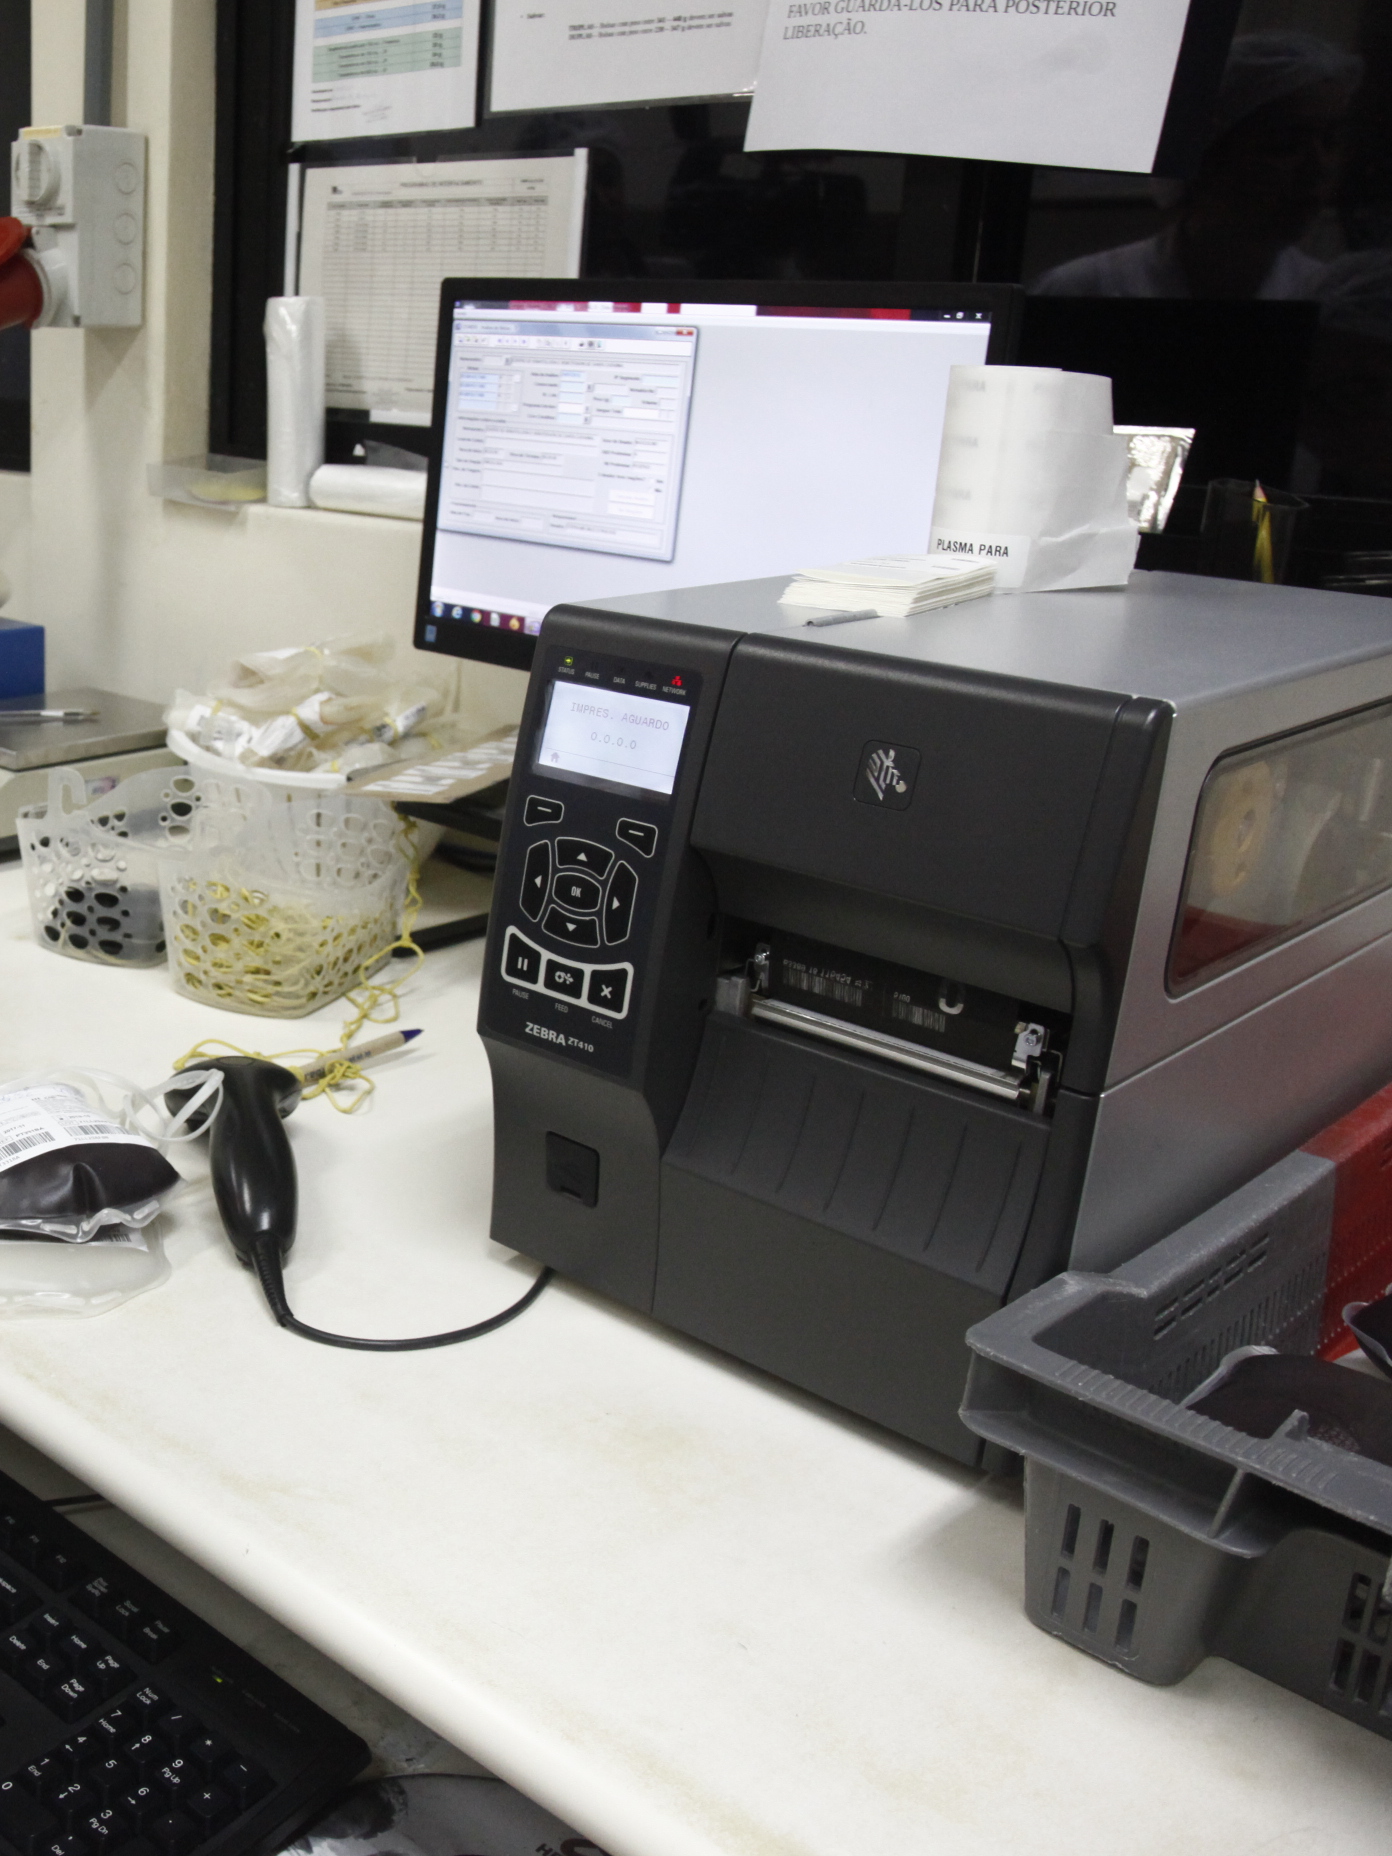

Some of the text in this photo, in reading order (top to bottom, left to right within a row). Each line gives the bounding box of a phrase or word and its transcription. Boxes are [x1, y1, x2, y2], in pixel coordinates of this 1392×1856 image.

[787, 0, 1117, 19] FAVOR GUARDA-LOS PARA POSTERIOR
[782, 18, 868, 40] LIBERAÇÃO.
[936, 538, 1009, 558] PLASMA PARA
[557, 666, 576, 676] STATUS
[584, 671, 601, 680] PAUSE
[612, 676, 626, 685] DATA
[634, 680, 658, 691] SUPPLIES
[661, 685, 687, 696] NETWORK
[570, 701, 670, 732] IMPRES. AGUARDO
[570, 885, 582, 899] OK
[512, 988, 530, 1000] PAUSE
[554, 1002, 569, 1014] FEED
[591, 1014, 614, 1030] CANCEL
[524, 1021, 594, 1053] ZEBRA ZT410
[9, 1634, 27, 1650] Delete
[70, 1634, 88, 1649] Home
[36, 1658, 51, 1671] End
[60, 1683, 78, 1699] Down
[69, 1678, 85, 1693] Page
[136, 1691, 152, 1706] Lock
[143, 1687, 159, 1701] Num
[98, 1718, 117, 1734] Home
[140, 1734, 153, 1745] 8
[171, 1758, 184, 1769] 9
[27, 1764, 43, 1777] End
[1, 1781, 13, 1791] 0
[137, 1786, 150, 1797] 6
[100, 1809, 113, 1820] 3
